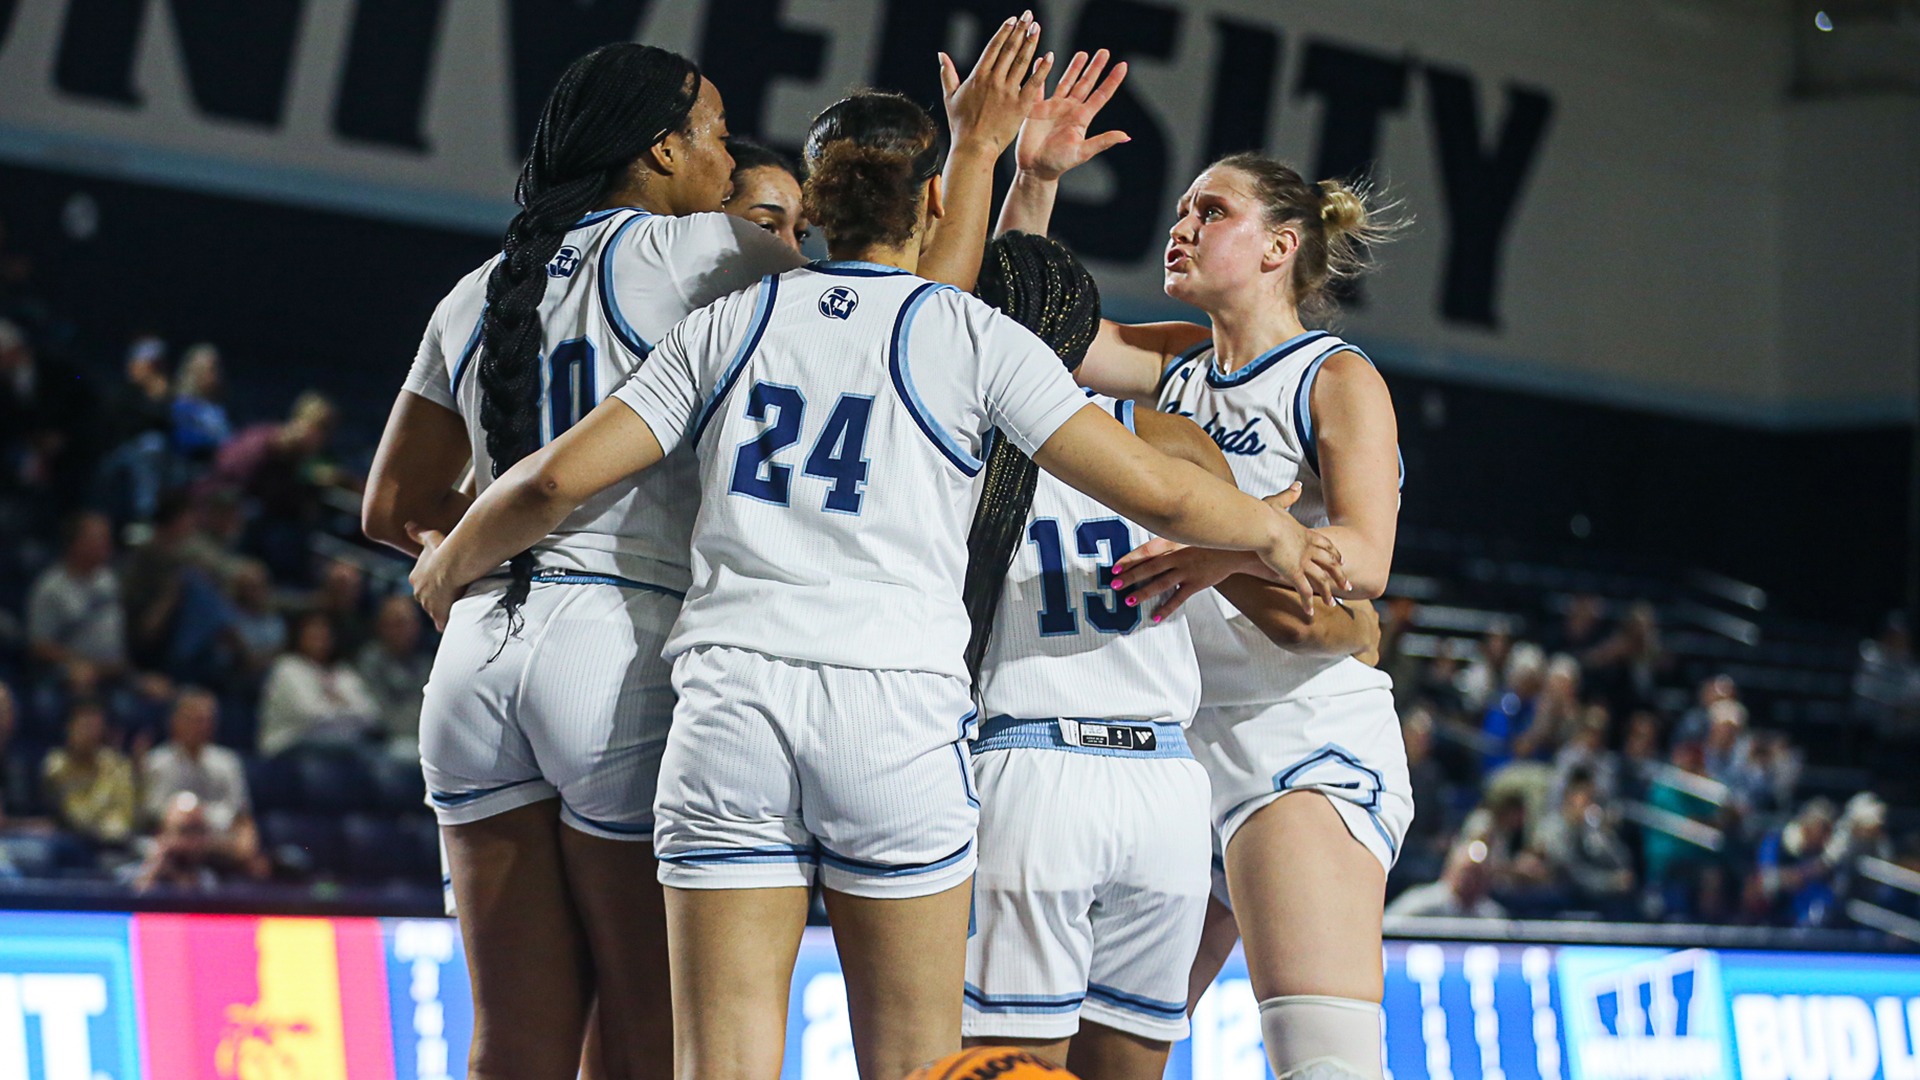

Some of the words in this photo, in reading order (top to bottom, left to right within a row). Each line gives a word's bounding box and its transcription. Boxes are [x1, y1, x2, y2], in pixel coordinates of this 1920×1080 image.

[537, 334, 599, 447] 0
[728, 379, 875, 516] 24
[1026, 516, 1143, 637] 13
[1732, 993, 1879, 1080] BUD
